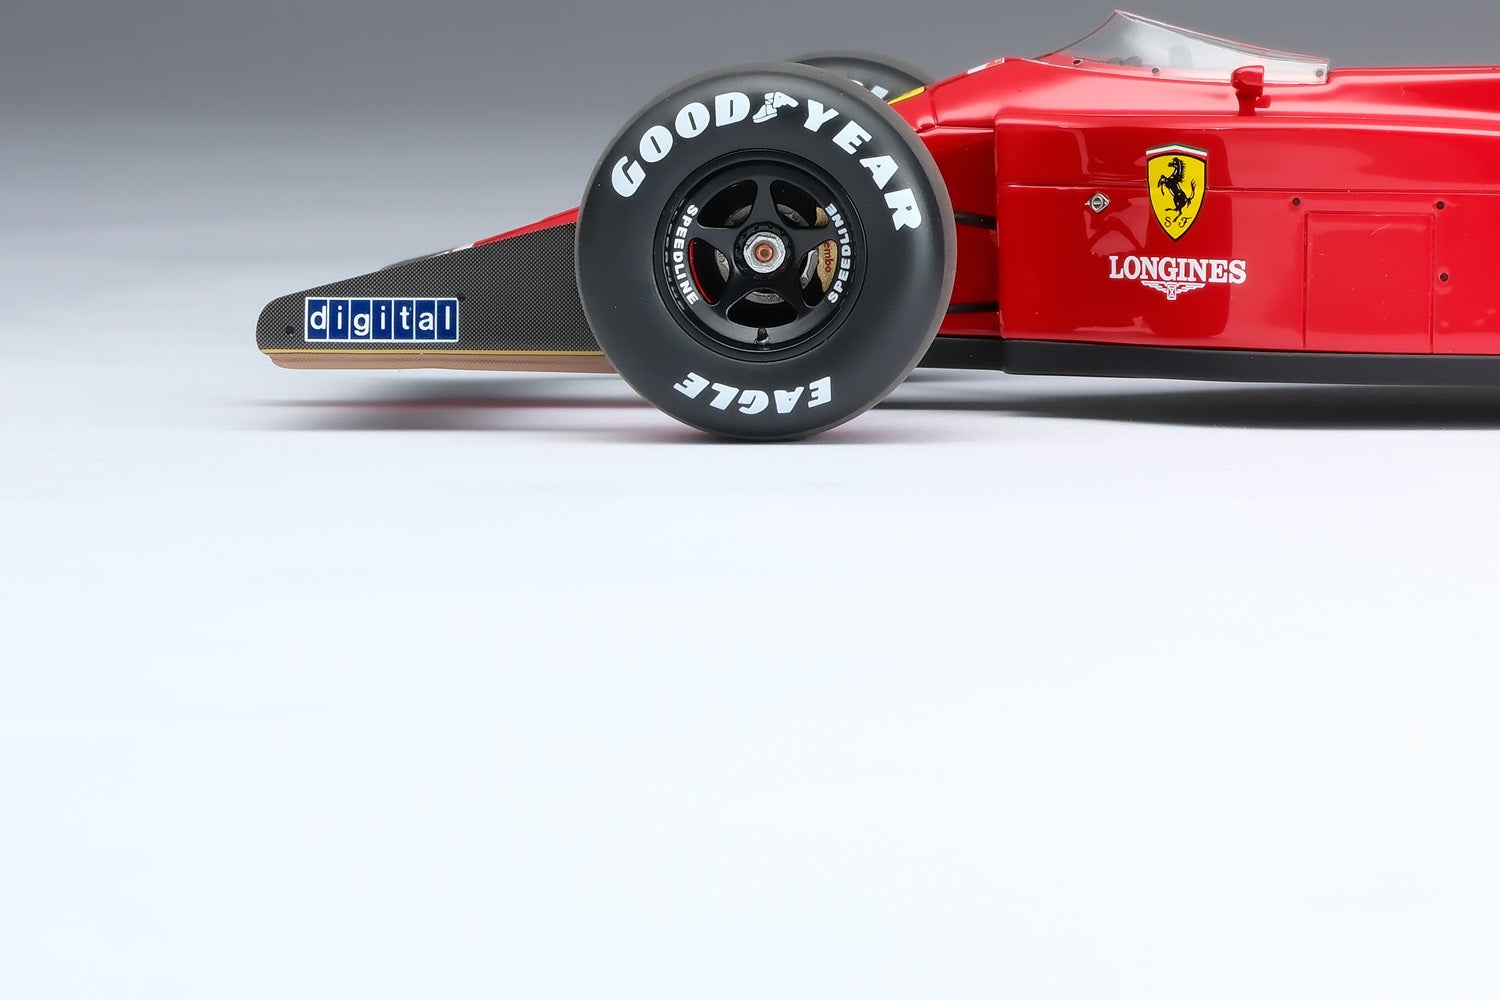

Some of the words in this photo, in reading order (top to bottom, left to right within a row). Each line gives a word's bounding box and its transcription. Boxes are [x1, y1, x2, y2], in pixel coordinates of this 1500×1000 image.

[611, 91, 923, 232] GOODYEAR
[672, 204, 700, 305] SPEEDLINE
[824, 203, 852, 304] SPEEDLINE
[1108, 255, 1247, 285] LONGINES
[309, 302, 452, 338] digital
[673, 371, 832, 415] EAGLE
